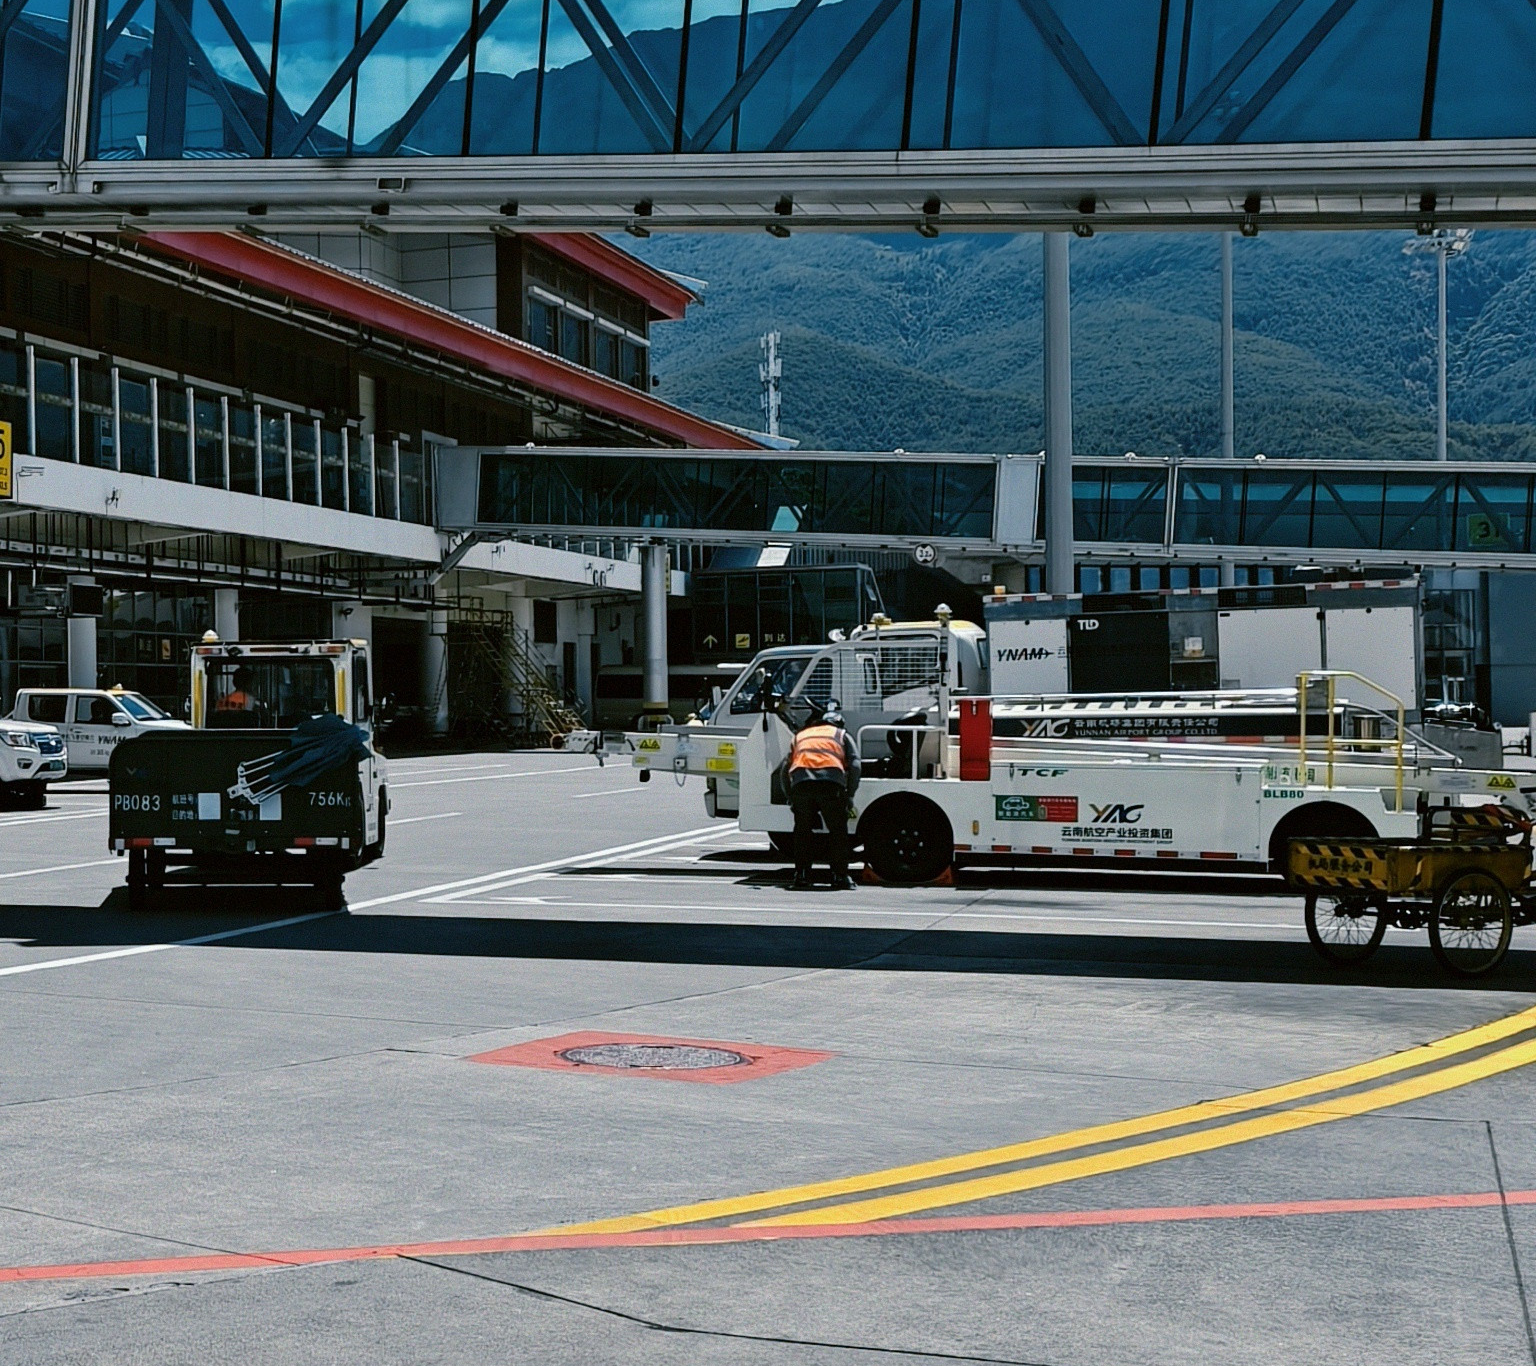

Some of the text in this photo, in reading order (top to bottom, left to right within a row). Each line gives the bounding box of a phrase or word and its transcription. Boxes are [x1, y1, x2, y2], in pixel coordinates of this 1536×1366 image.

[1077, 619, 1100, 631] TLD
[996, 647, 1046, 663] YNAM
[1074, 728, 1112, 736] YUNNAN
[1113, 728, 1150, 736] AIRPORT
[1017, 768, 1069, 777] TCF
[114, 794, 161, 811] PB083
